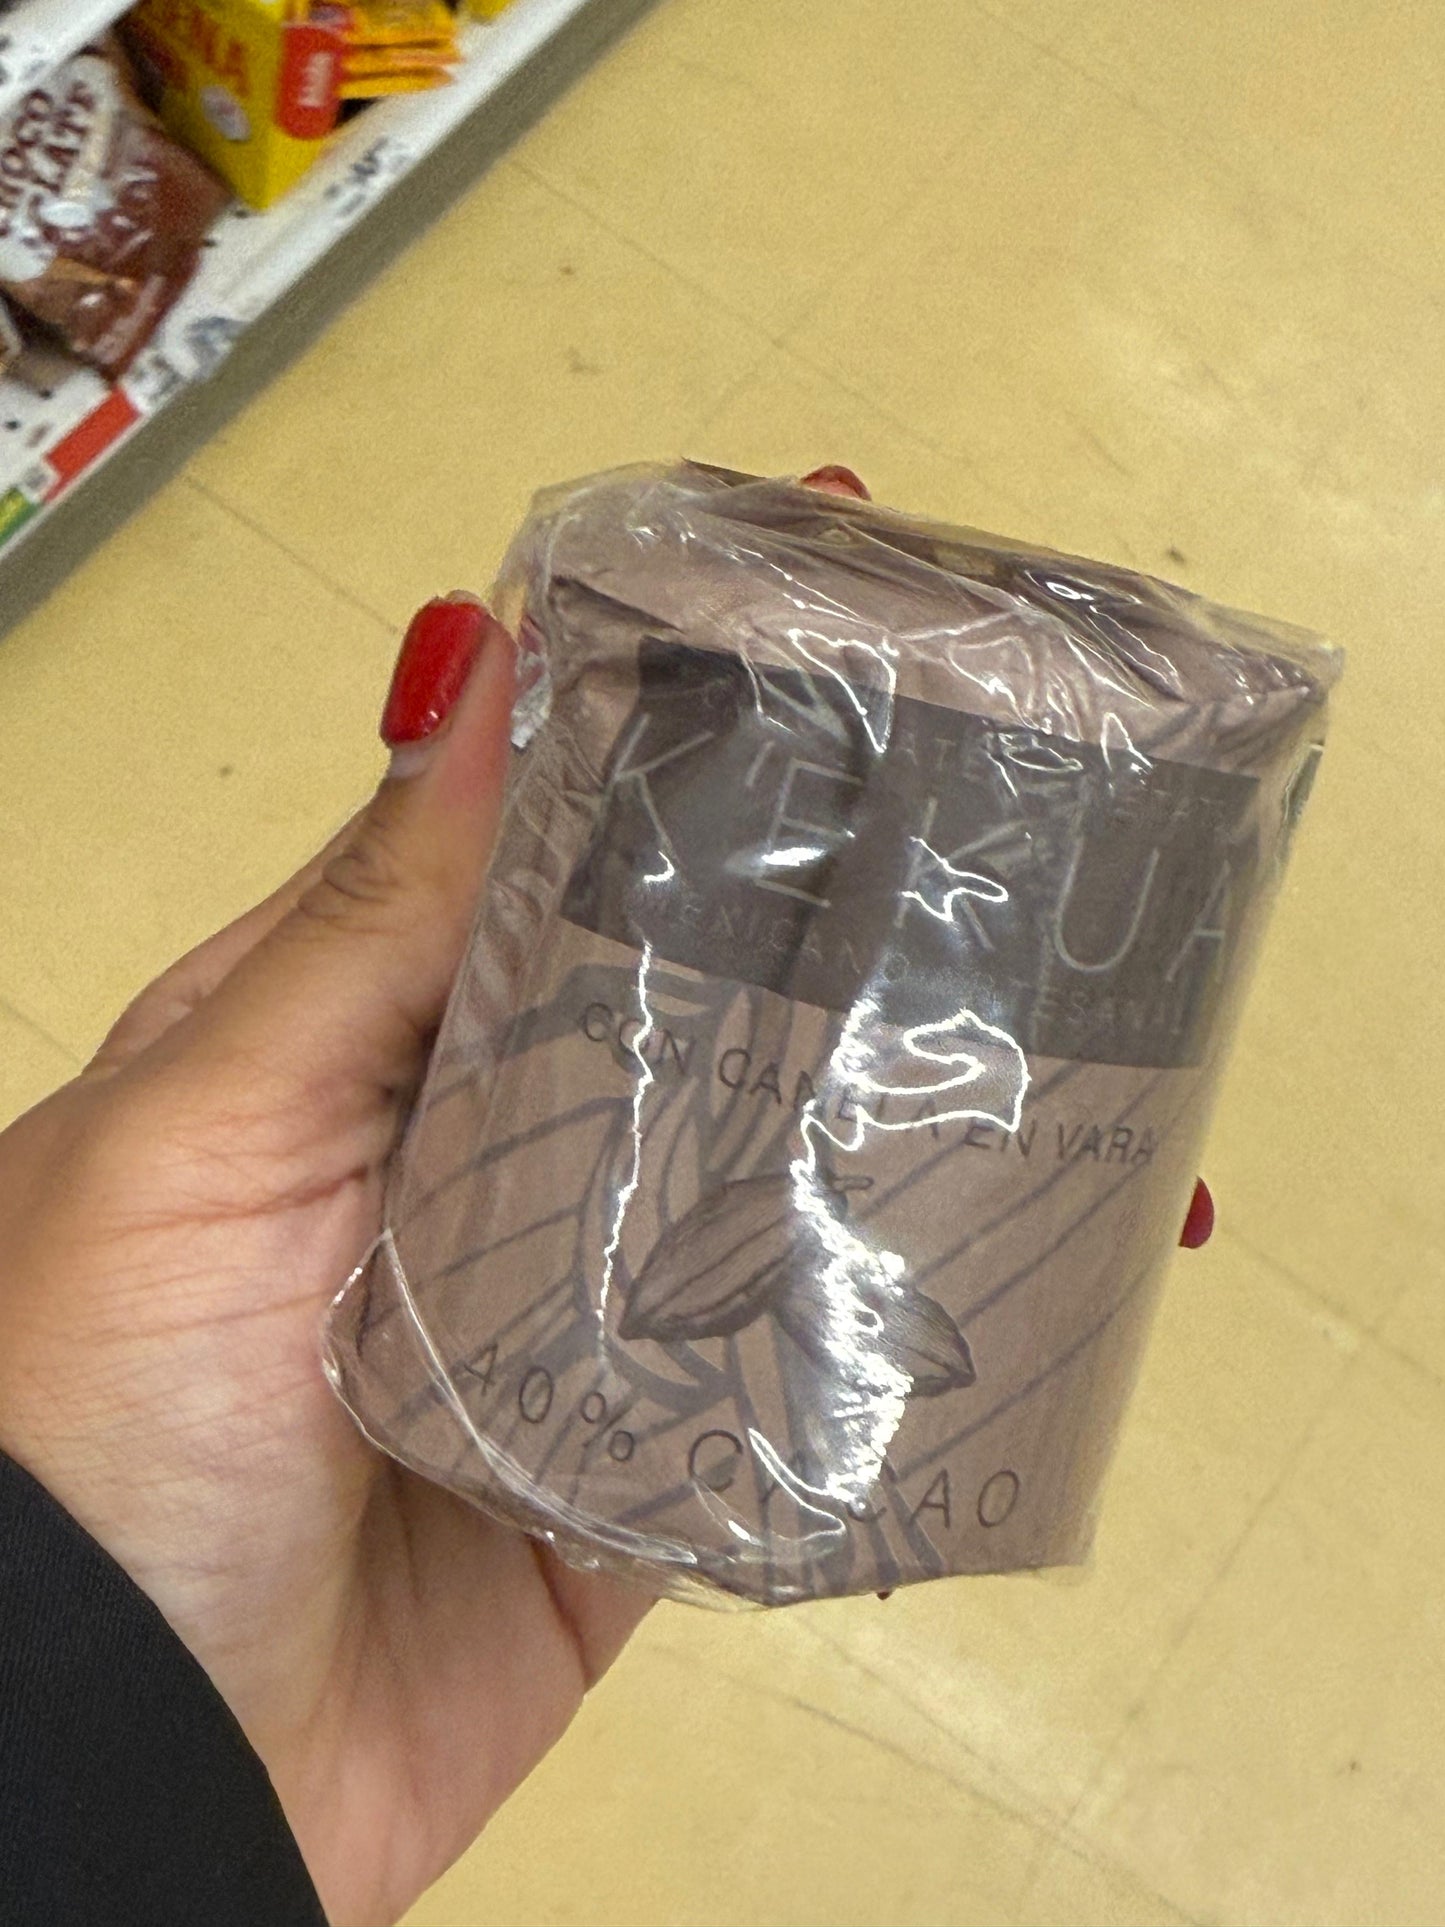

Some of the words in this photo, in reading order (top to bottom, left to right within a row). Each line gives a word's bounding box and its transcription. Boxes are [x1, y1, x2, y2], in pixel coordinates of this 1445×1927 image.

[583, 1002, 696, 1077] CON
[1057, 1123, 1158, 1165] VARA
[463, 1342, 635, 1462] 40%
[689, 1428, 1020, 1529] CAO
